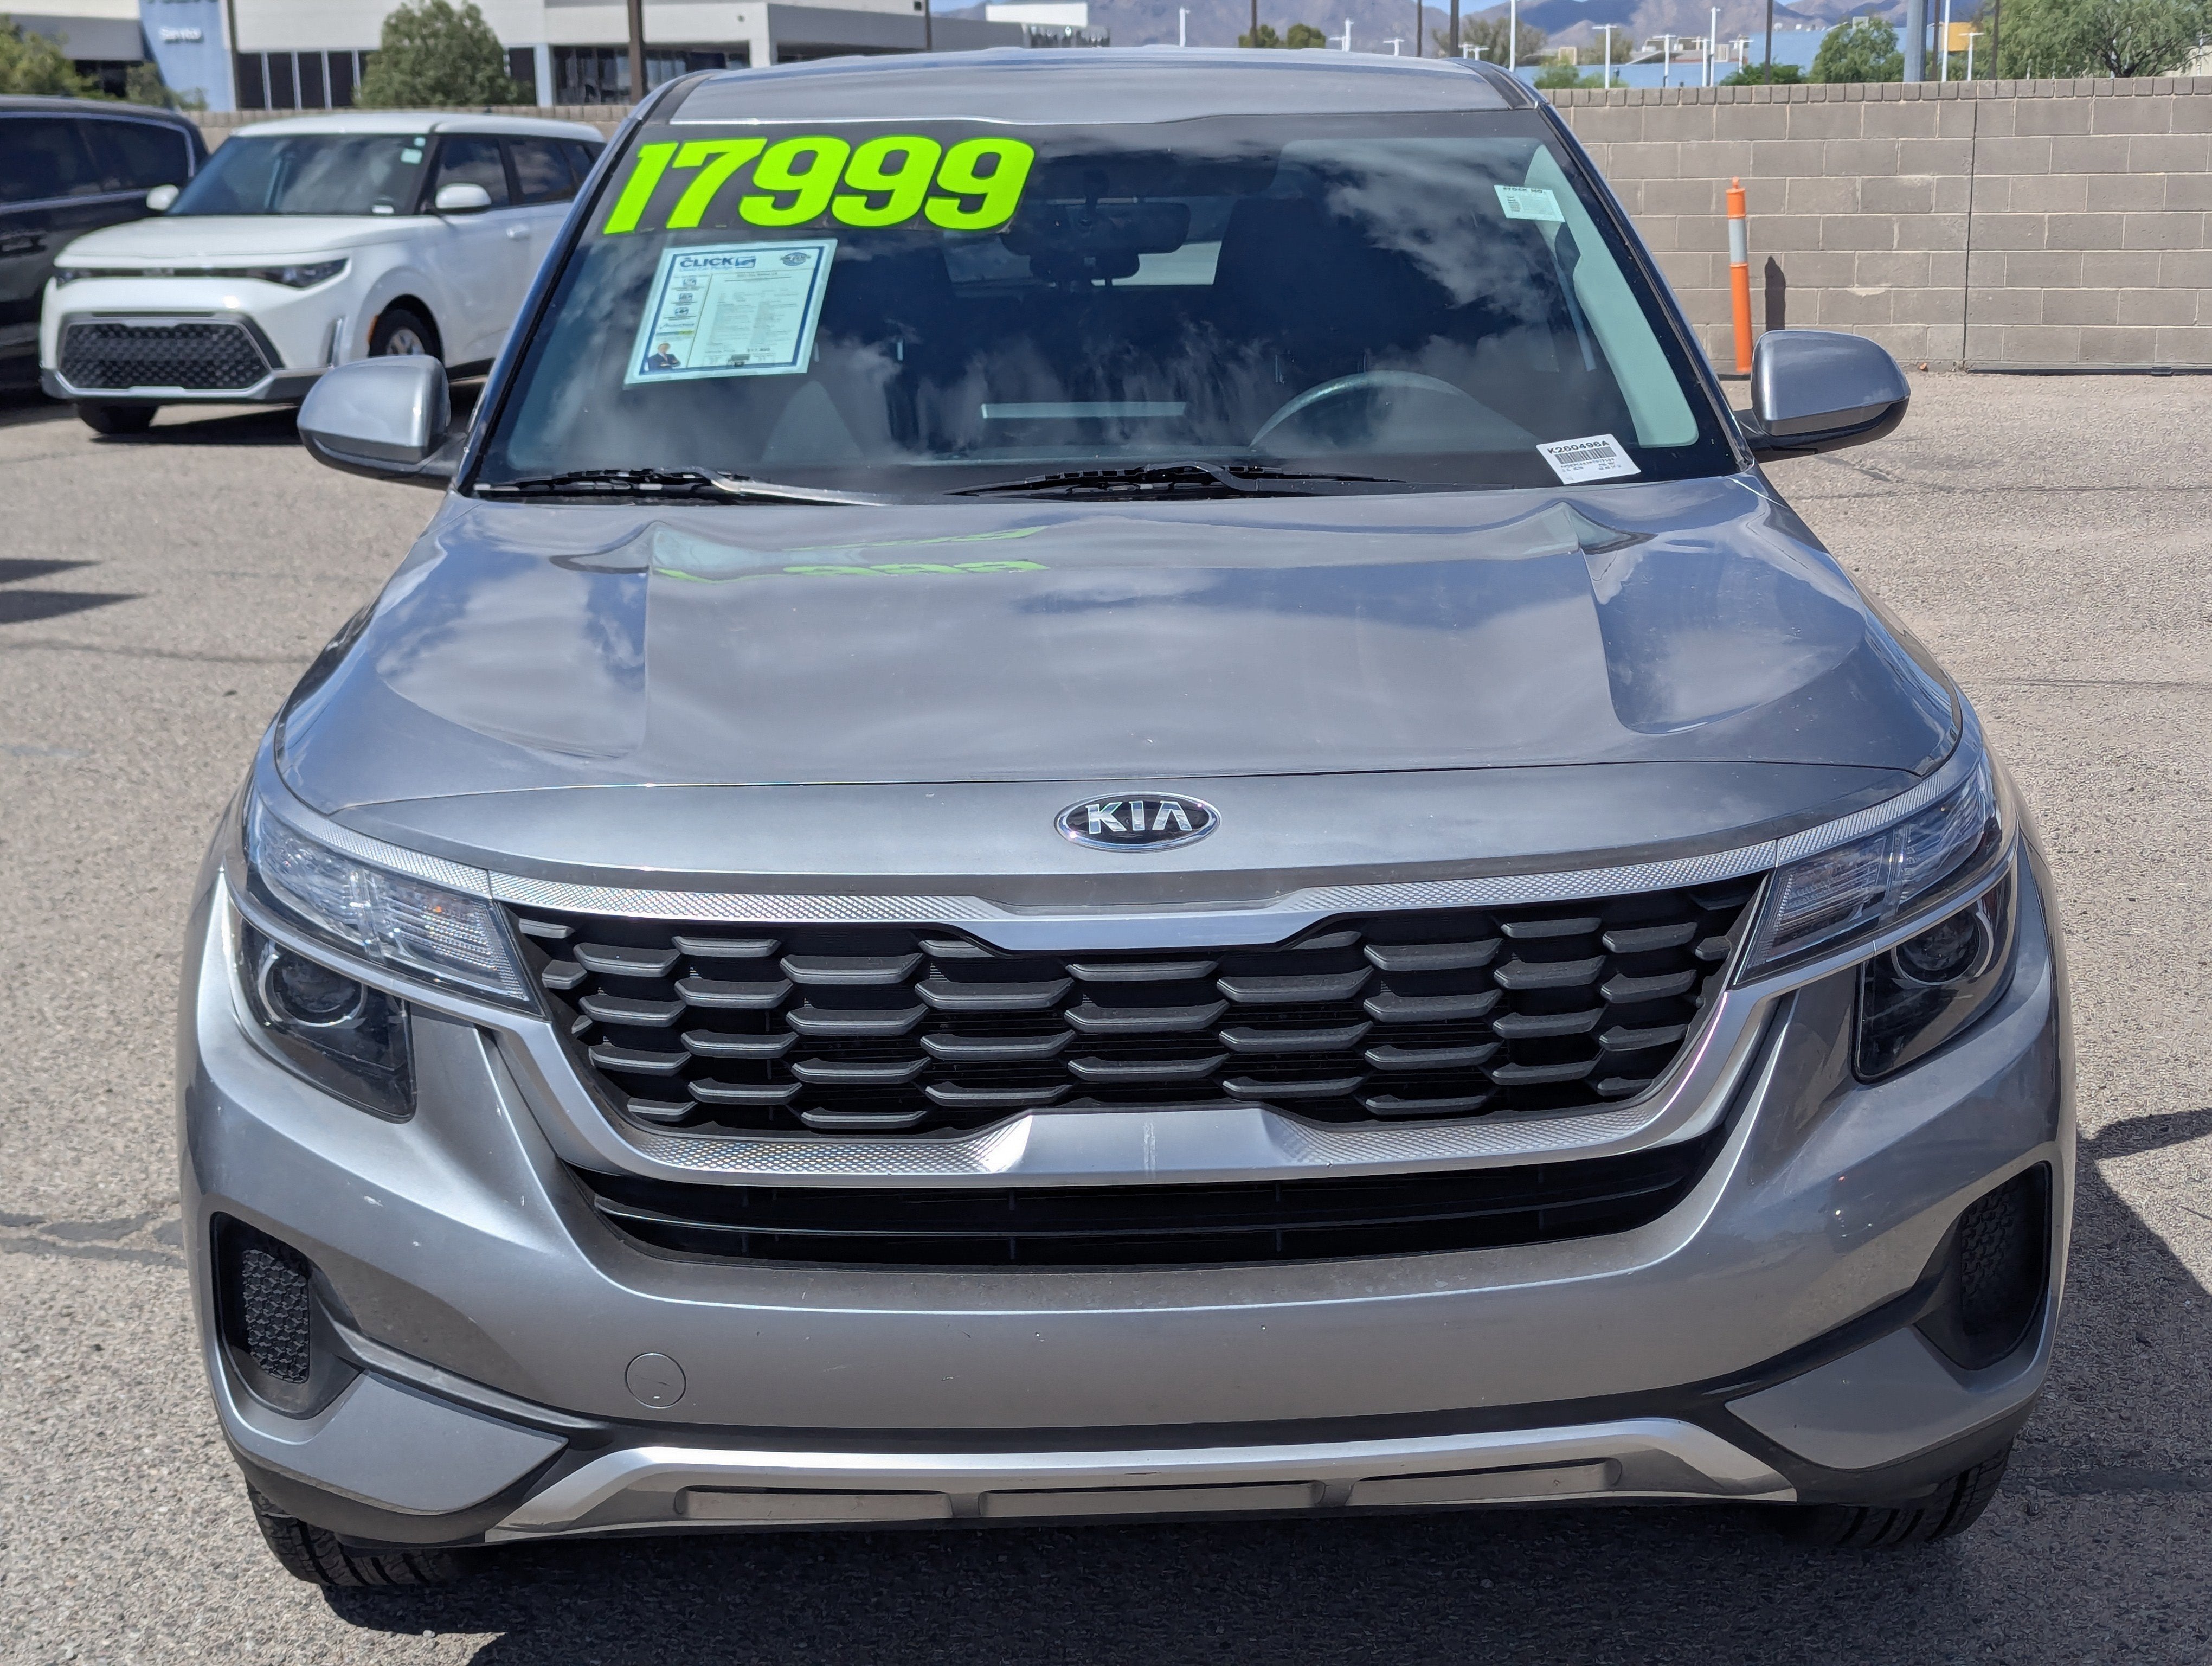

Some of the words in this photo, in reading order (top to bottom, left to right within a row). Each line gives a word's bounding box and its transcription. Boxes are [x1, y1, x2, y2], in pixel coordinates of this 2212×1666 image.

[603, 136, 1035, 233] 17999
[680, 257, 735, 267] CLICK
[1085, 800, 1193, 835] KIA
